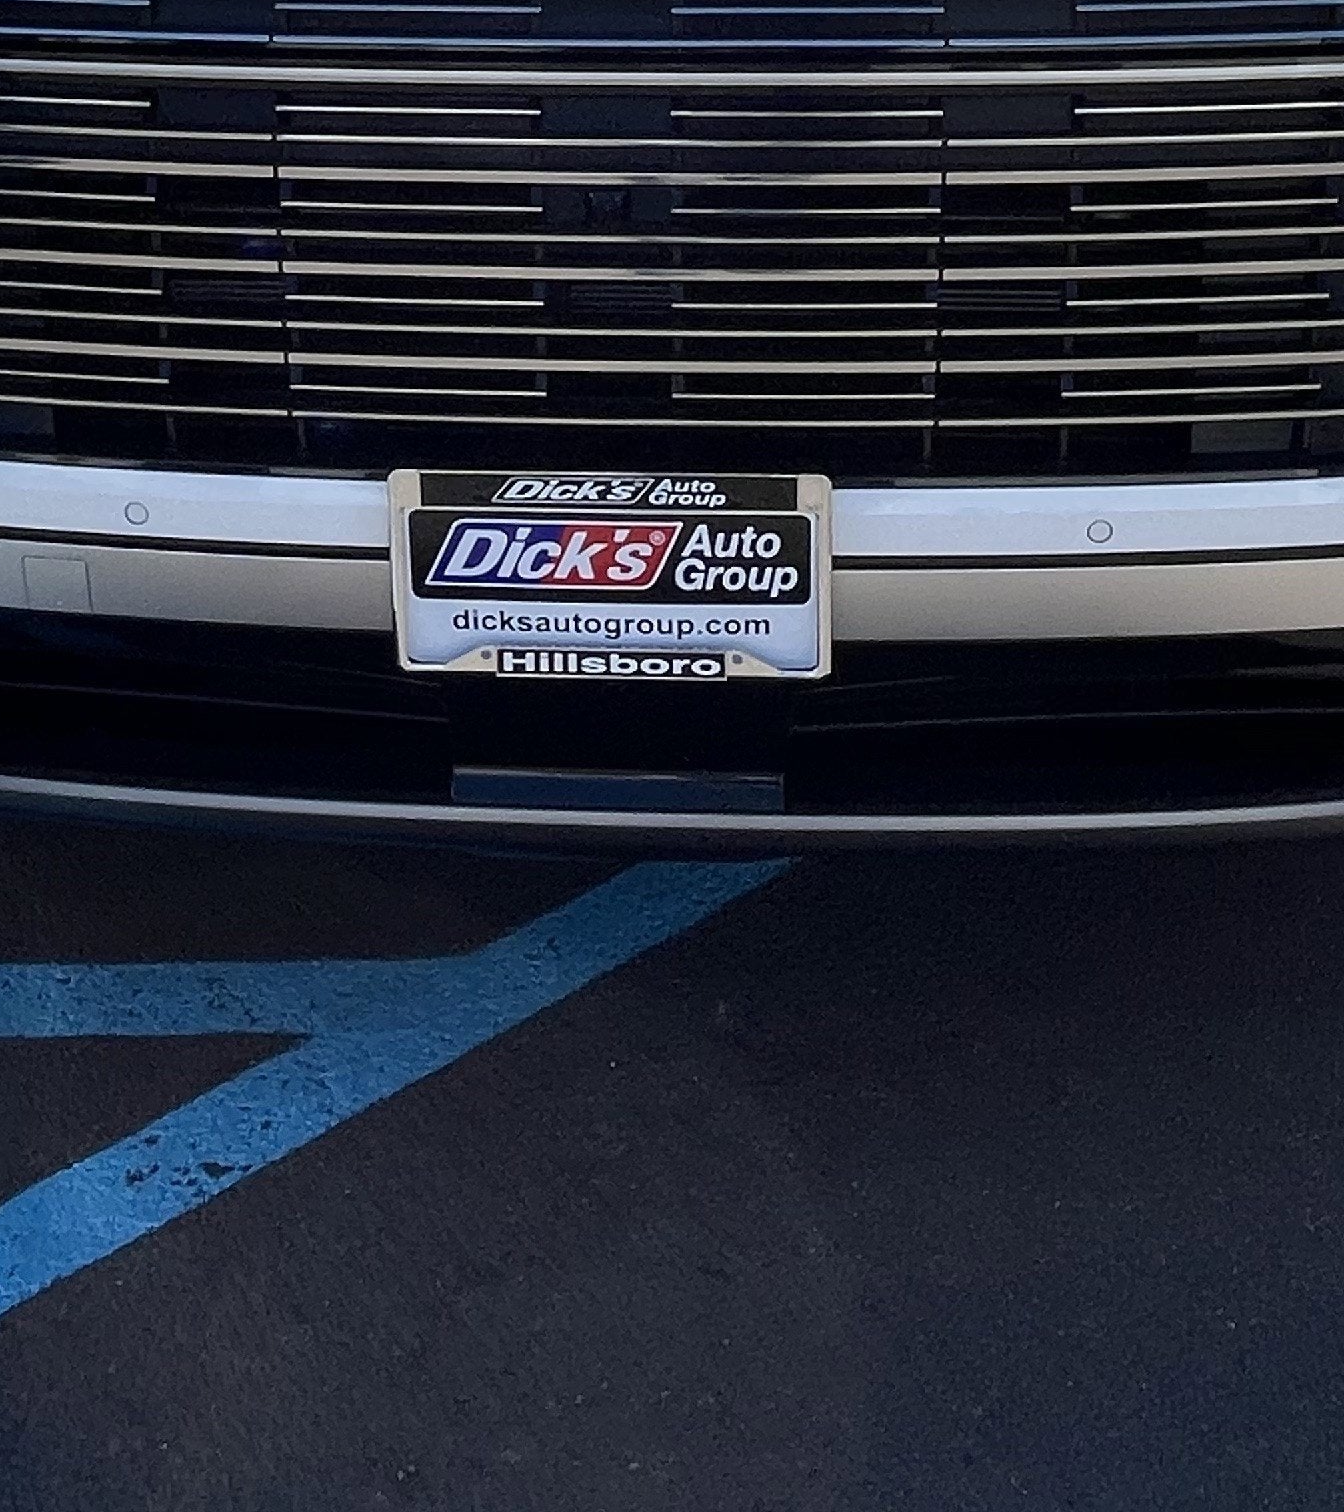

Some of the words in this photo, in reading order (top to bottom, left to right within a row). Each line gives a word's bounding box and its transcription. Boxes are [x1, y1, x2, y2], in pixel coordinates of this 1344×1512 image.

[649, 491, 726, 507] Group
[654, 479, 716, 493] Auto
[443, 527, 656, 580] Dick's
[681, 524, 782, 559] Auto
[674, 560, 799, 597] Group
[452, 609, 771, 640] dicksautogroup.com
[501, 651, 722, 677] Hillsboro
